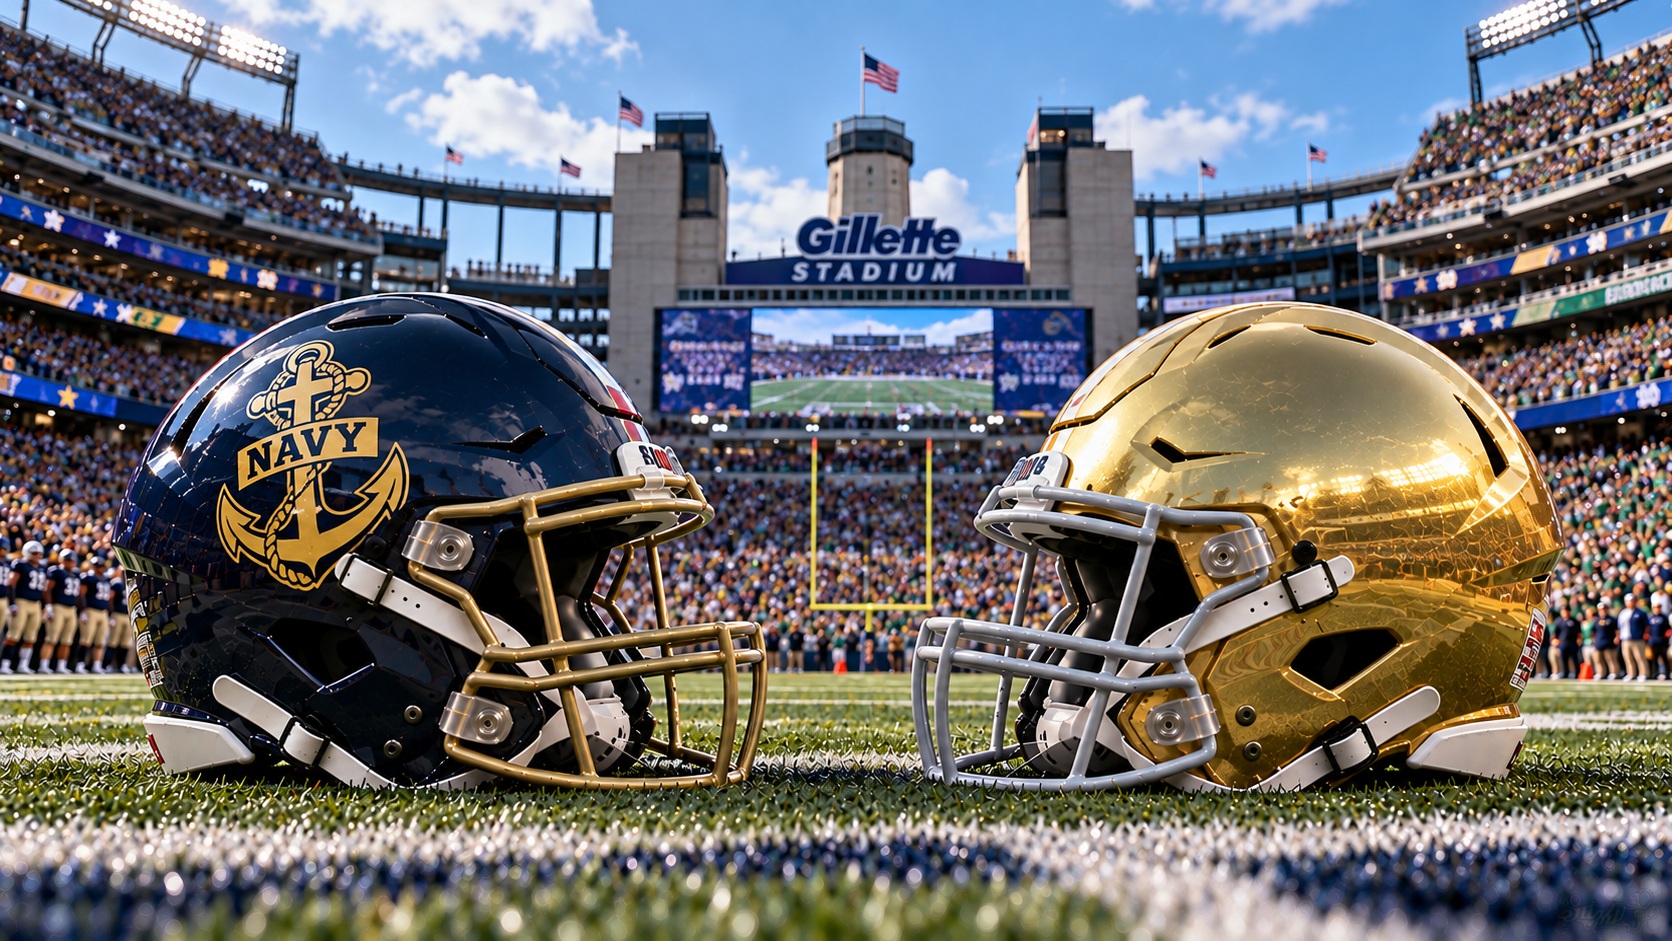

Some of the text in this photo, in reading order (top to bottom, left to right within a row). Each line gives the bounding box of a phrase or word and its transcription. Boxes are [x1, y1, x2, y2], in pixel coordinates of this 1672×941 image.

[797, 213, 961, 259] Gillette
[791, 262, 957, 282] STADIUM
[247, 422, 366, 480] NAVY
